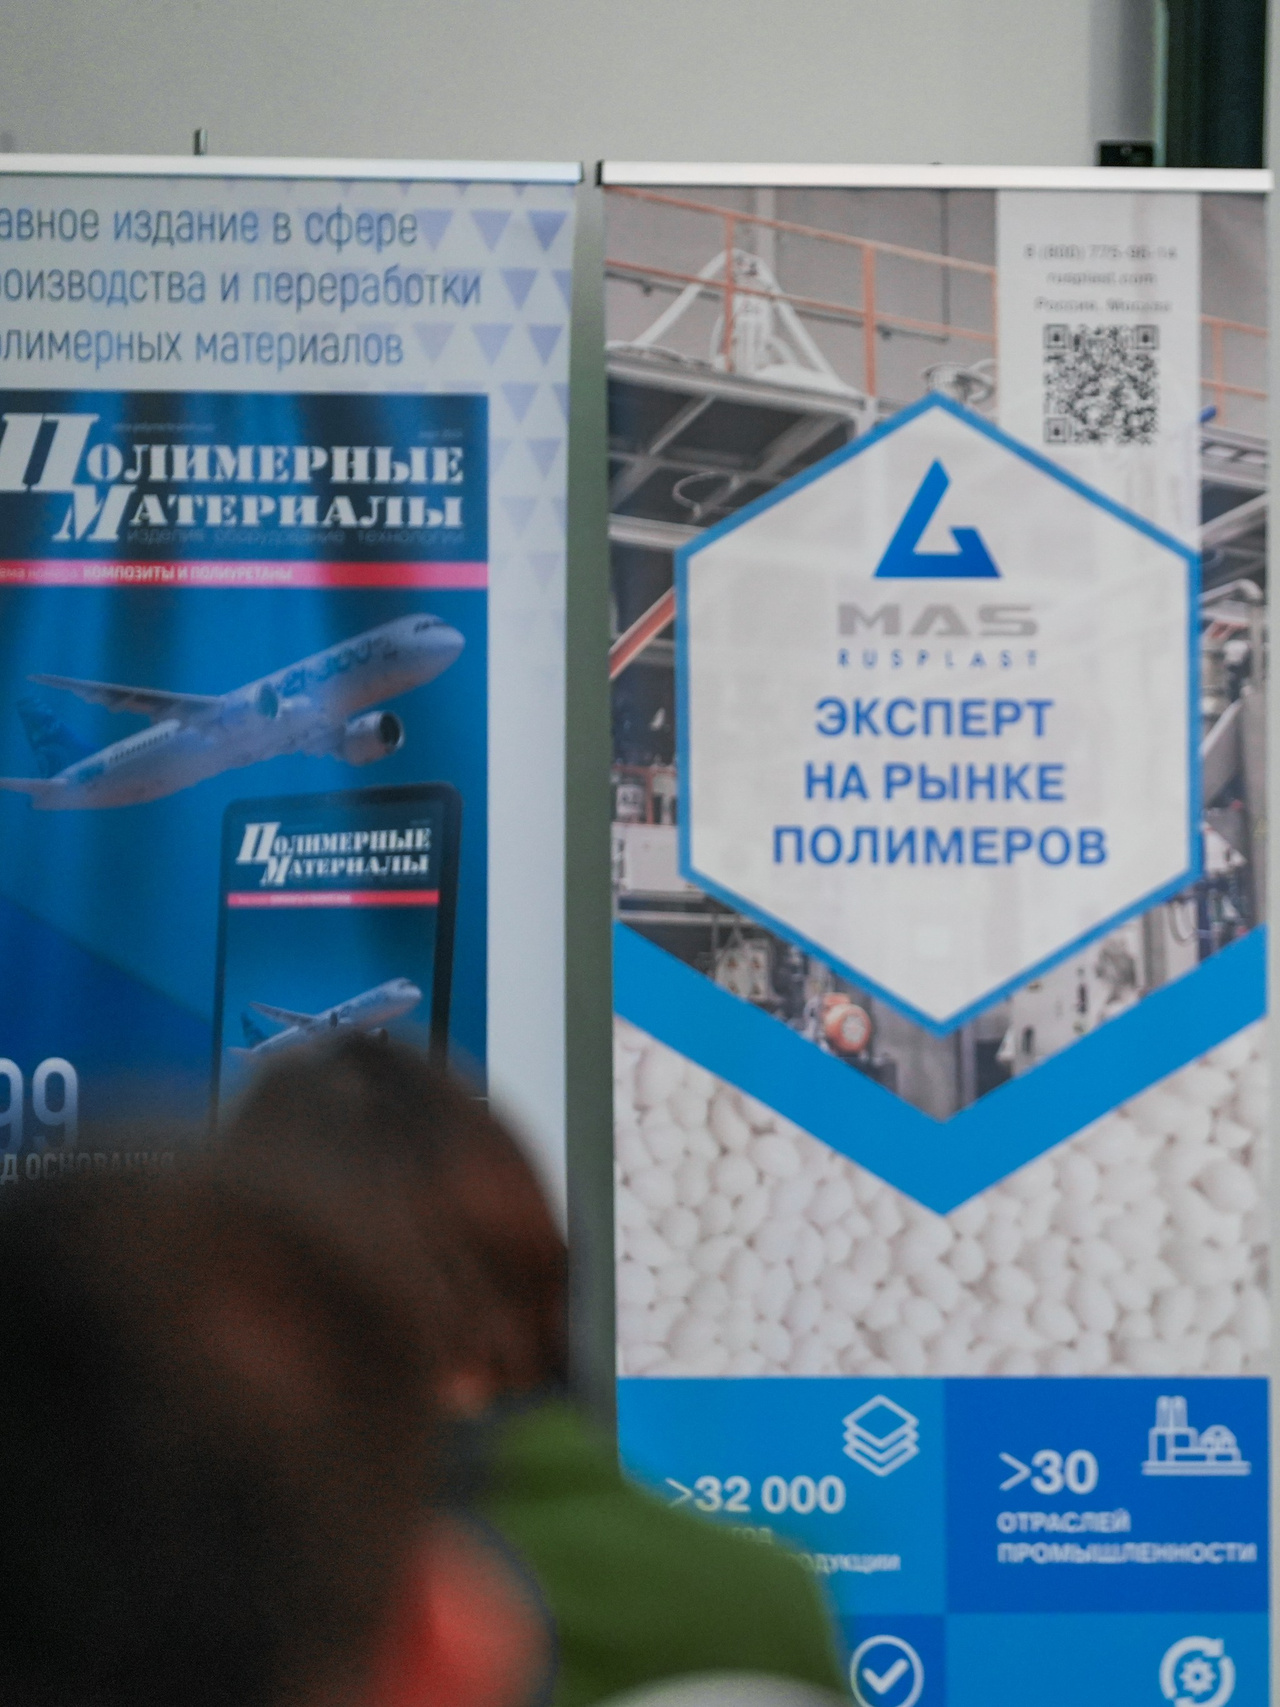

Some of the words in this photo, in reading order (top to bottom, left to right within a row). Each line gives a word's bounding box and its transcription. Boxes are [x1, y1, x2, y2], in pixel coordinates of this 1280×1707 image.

[113, 208, 260, 246] издание
[272, 211, 293, 244] в
[304, 202, 418, 253] сфере
[0, 268, 206, 308] оизводства
[220, 272, 239, 304] и
[253, 263, 482, 314] переработки
[0, 329, 182, 371] лимерных
[195, 331, 404, 373] материалов
[0, 412, 465, 493] ПОЛИМЕРНЫЕ
[51, 483, 464, 542] МАТЕРИАЛЫ
[838, 603, 1038, 637] MAS
[839, 650, 1038, 668] RUSPLAST
[815, 698, 1053, 738] ЭКСПЕРТ
[805, 763, 869, 801] НА
[883, 764, 1066, 802] РЫНКЕ
[236, 821, 432, 865] ПОЛИМЕРНЫЕ
[773, 826, 1108, 867] ПОЛИМЕРОВ
[260, 854, 430, 887] МАТЕРИАЛЫ
[998, 1449, 1099, 1494] >30
[761, 1475, 846, 1514] 000
[996, 1507, 1131, 1533] ОТРАСЛЕЙ
[997, 1541, 1258, 1564] ПРОМЫШЛЕННОСТИ
